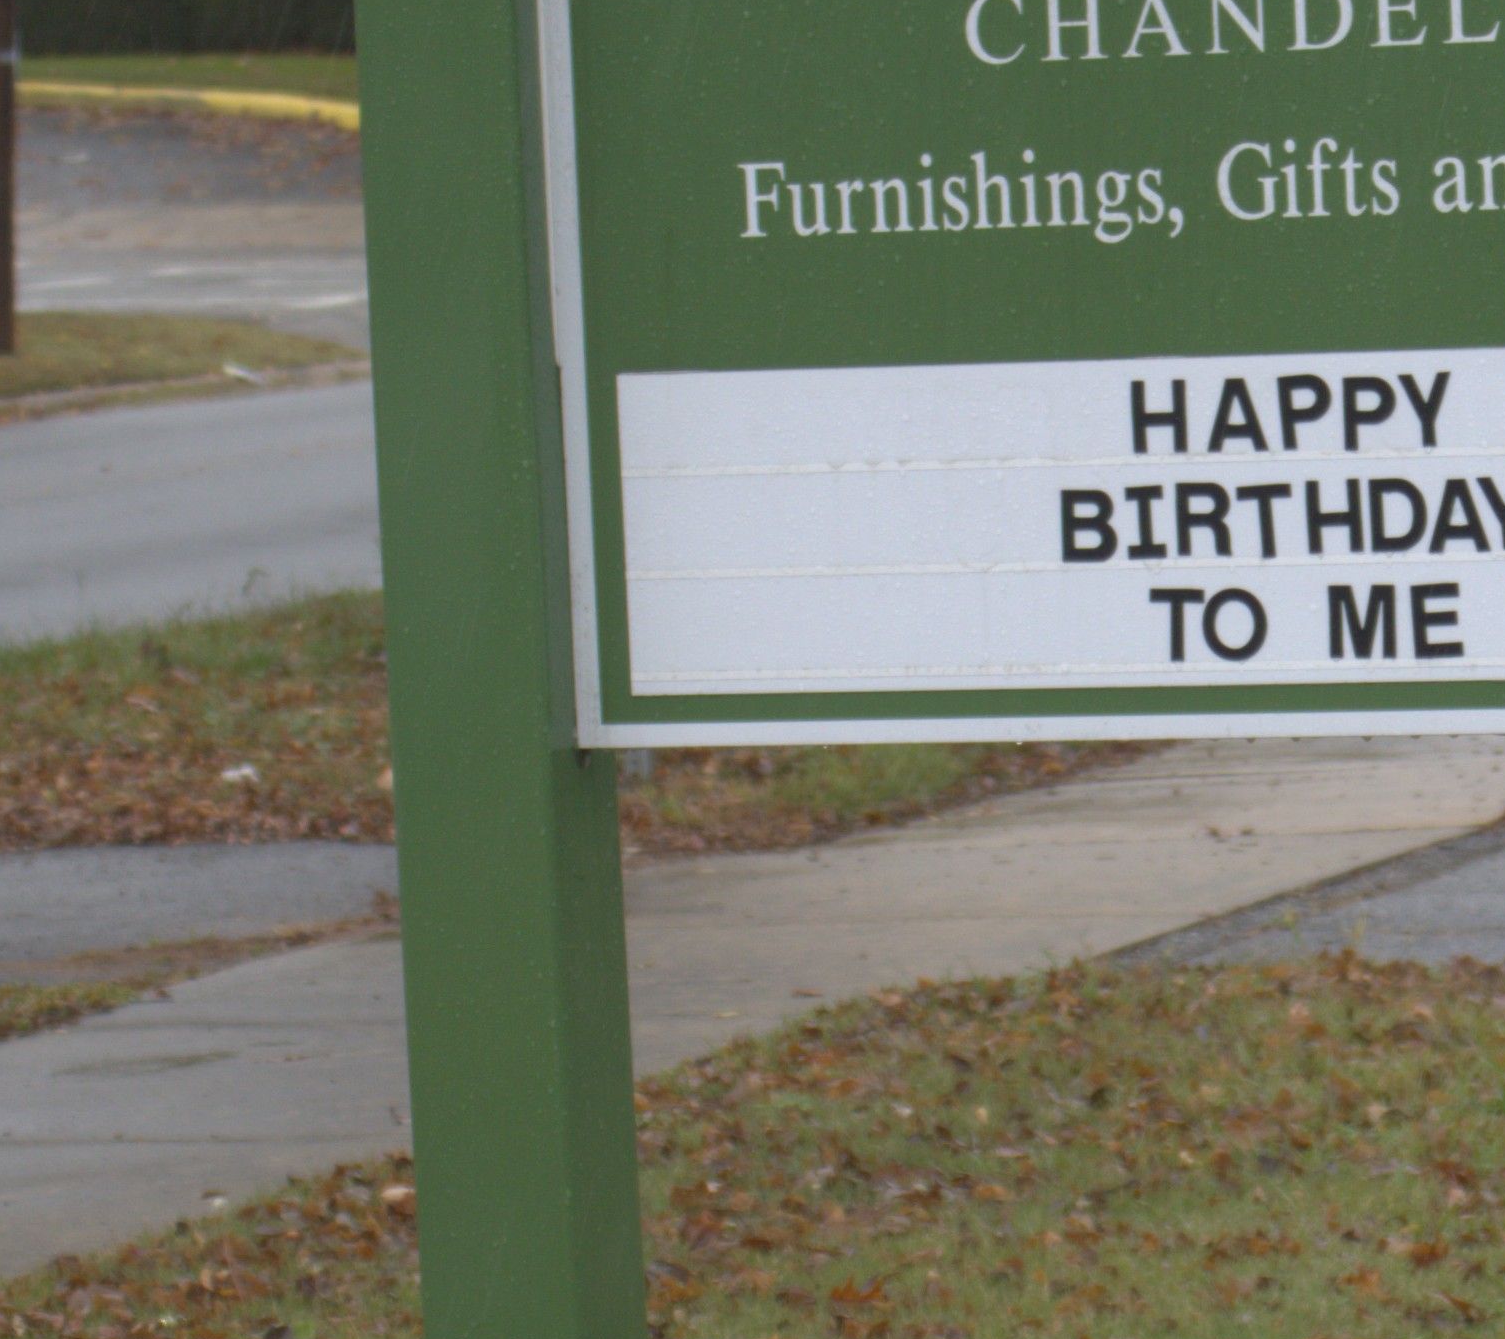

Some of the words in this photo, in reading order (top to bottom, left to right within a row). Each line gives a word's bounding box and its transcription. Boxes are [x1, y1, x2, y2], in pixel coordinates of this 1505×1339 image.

[737, 148, 1184, 244] Furnishings,
[1215, 136, 1401, 221] Gifts
[1131, 371, 1451, 453] HAPPY
[1149, 588, 1268, 661] TO
[1328, 582, 1464, 659] ME
